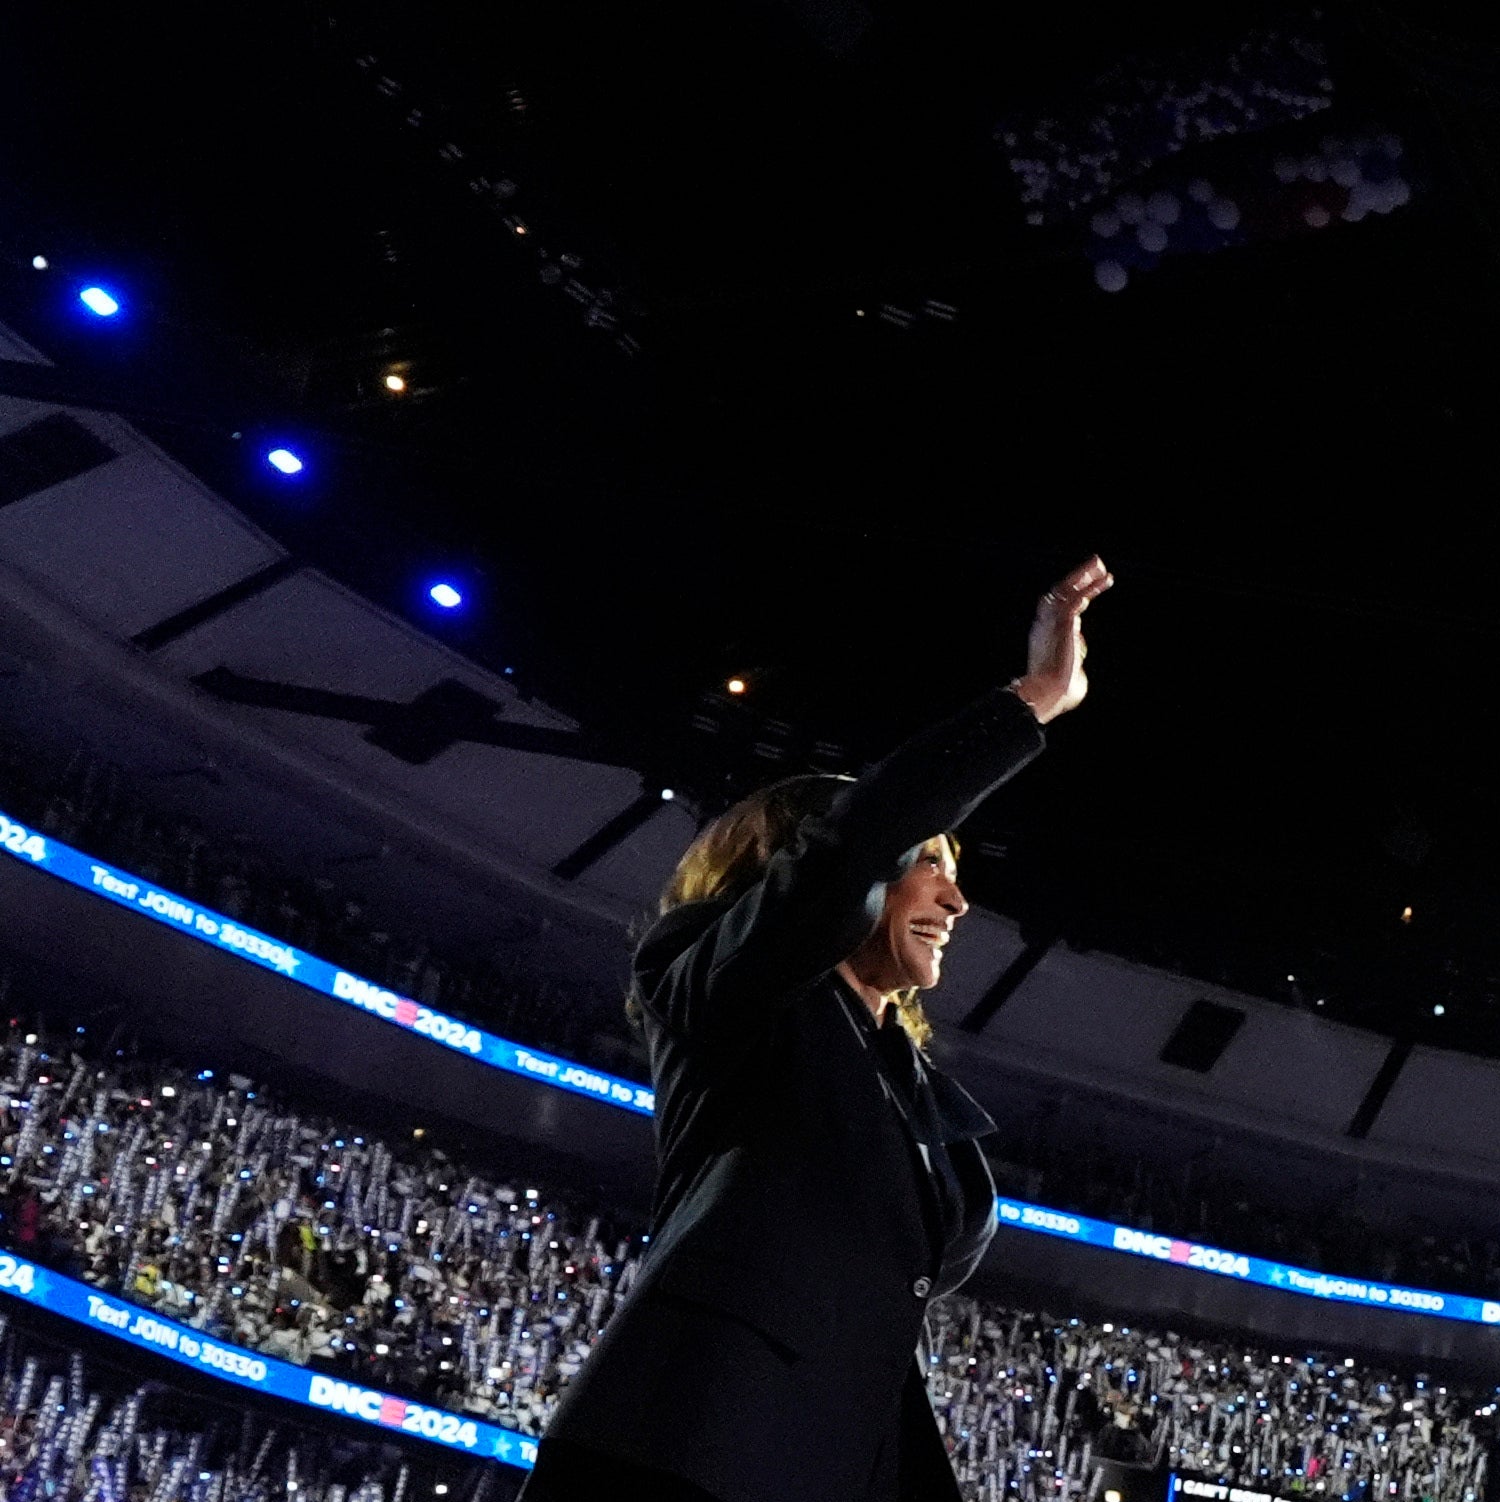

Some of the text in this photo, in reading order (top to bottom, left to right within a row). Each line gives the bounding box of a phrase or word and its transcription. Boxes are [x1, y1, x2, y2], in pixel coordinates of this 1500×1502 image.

[91, 866, 139, 899] Text
[138, 891, 194, 924] JOIN
[195, 914, 219, 935] to
[333, 971, 482, 1053] DNC 2024
[516, 1050, 633, 1102] Text JOIN to
[1113, 1227, 1250, 1277] DNC 2024
[88, 1295, 129, 1329] Text
[127, 1316, 179, 1349] JOIN
[179, 1336, 202, 1357] to
[309, 1375, 478, 1447] DNC 2024
